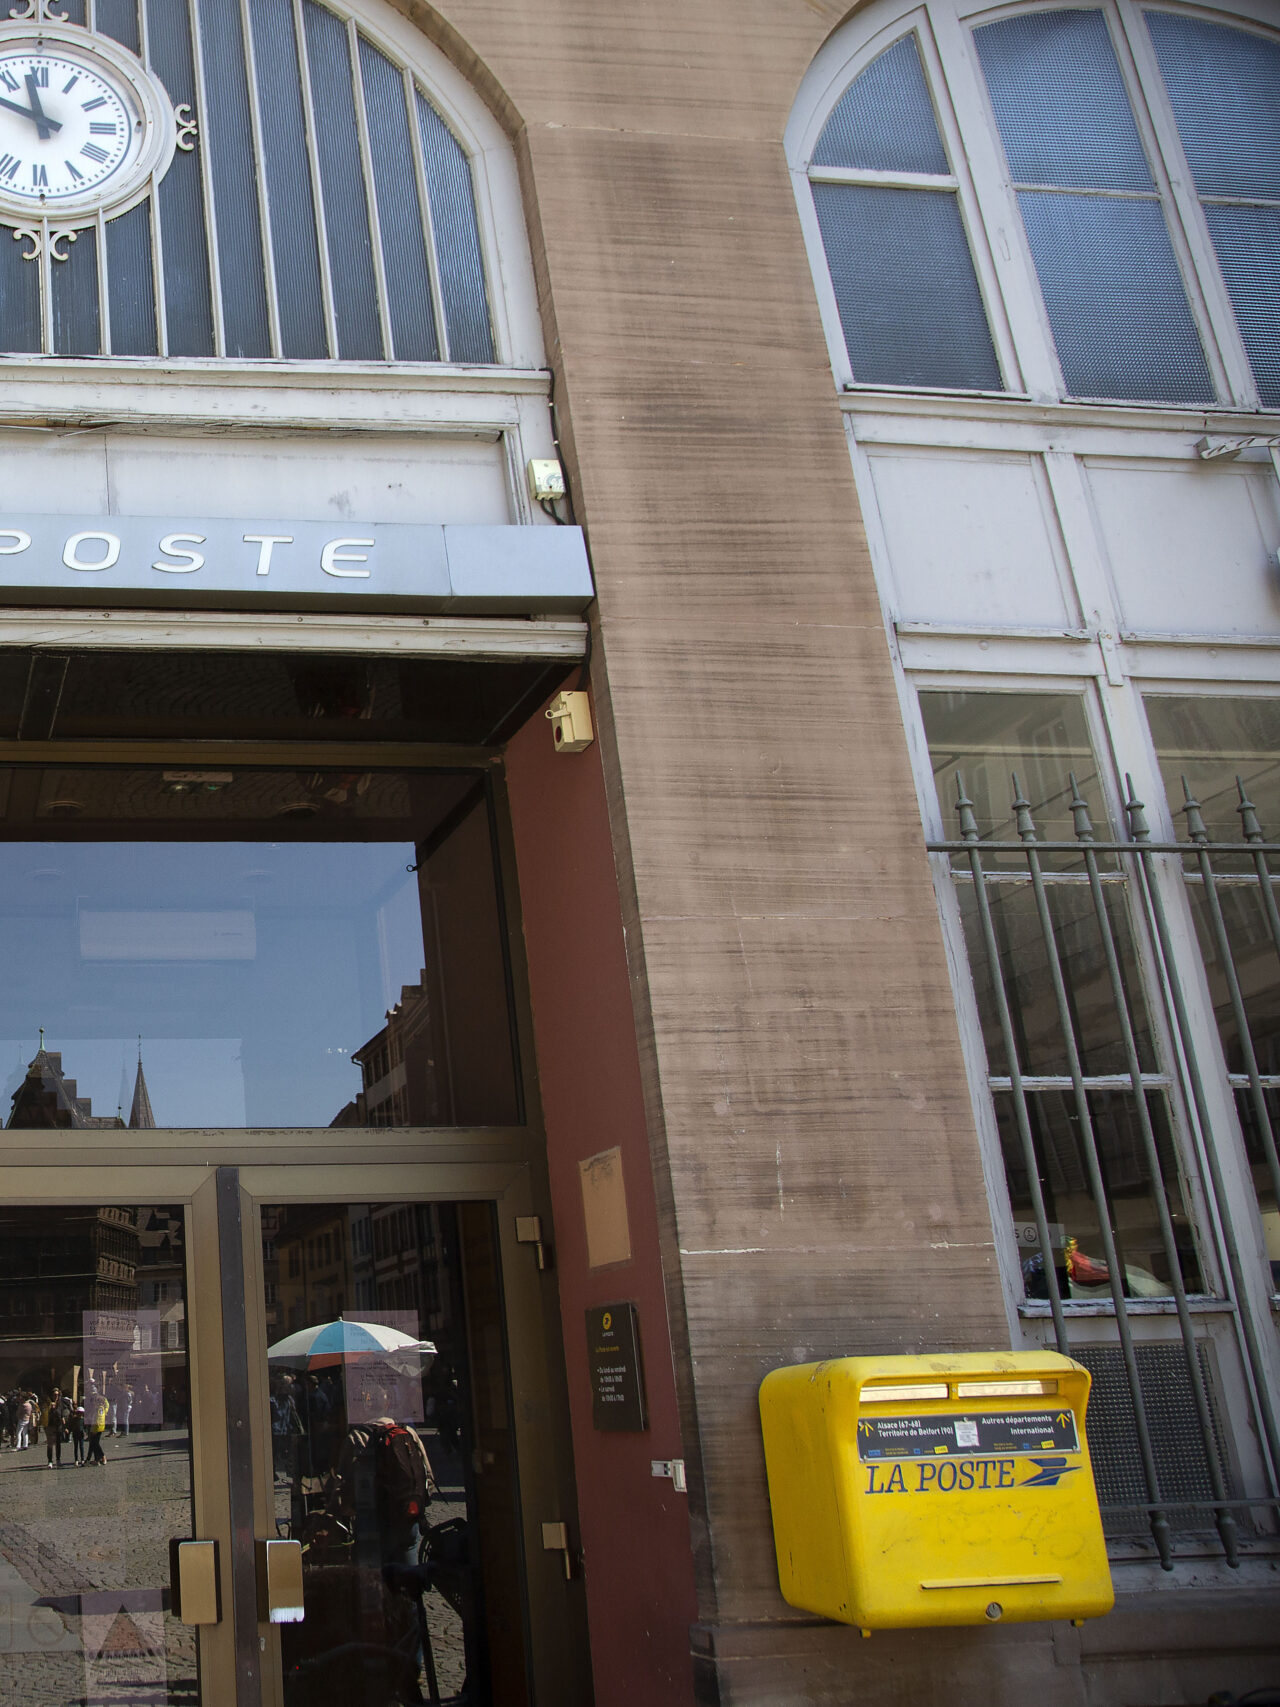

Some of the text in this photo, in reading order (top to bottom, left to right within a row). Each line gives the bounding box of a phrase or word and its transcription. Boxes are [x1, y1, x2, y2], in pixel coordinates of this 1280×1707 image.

[877, 1419, 921, 1429] Alsace (67-68)
[981, 1414, 1053, 1425] Autres départements
[878, 1426, 954, 1438] Territoire de Belfort (90)
[1010, 1426, 1055, 1435] International
[864, 1459, 1016, 1494] LA POSTE
